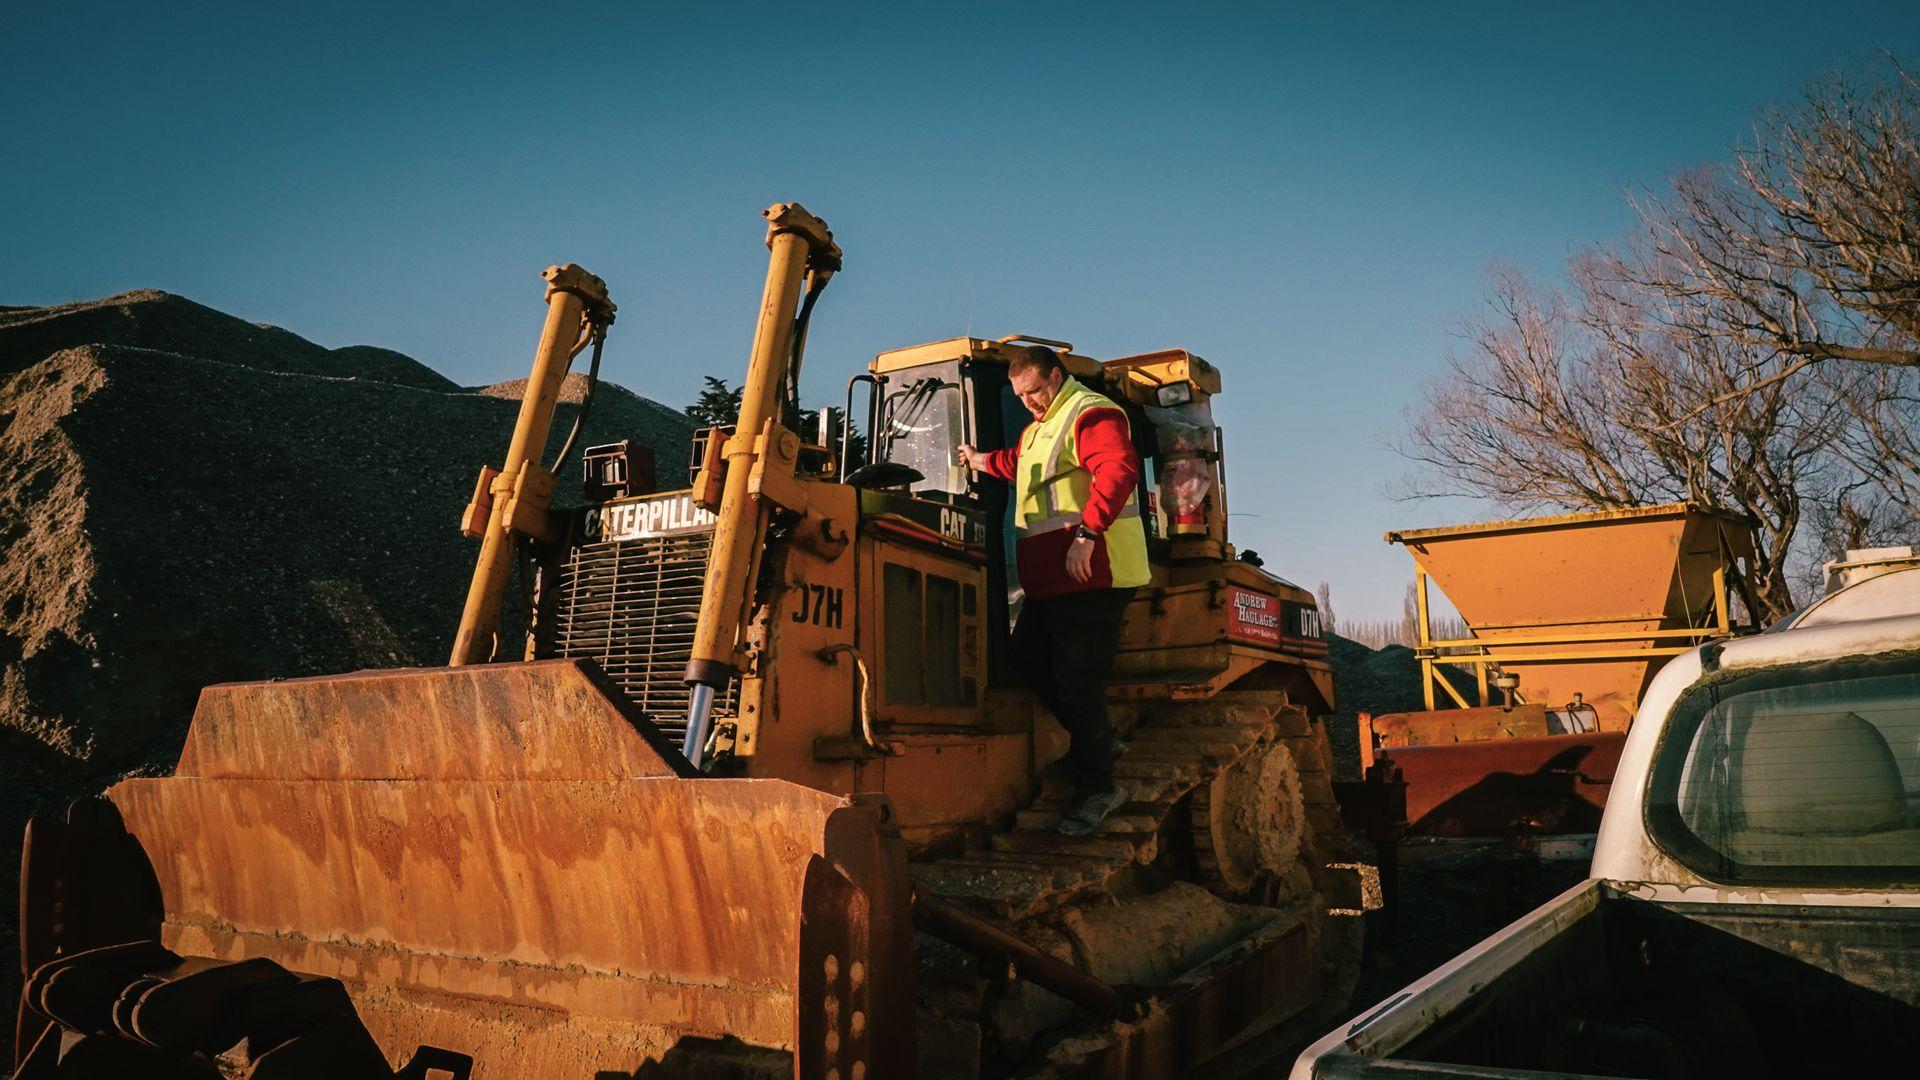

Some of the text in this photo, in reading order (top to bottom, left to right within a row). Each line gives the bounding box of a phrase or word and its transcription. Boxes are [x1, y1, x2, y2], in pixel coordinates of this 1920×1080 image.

[940, 507, 967, 541] CAT
[1234, 591, 1267, 610] ANDREW
[1238, 605, 1275, 628] HAULAGE
[1300, 608, 1320, 639] D7H
